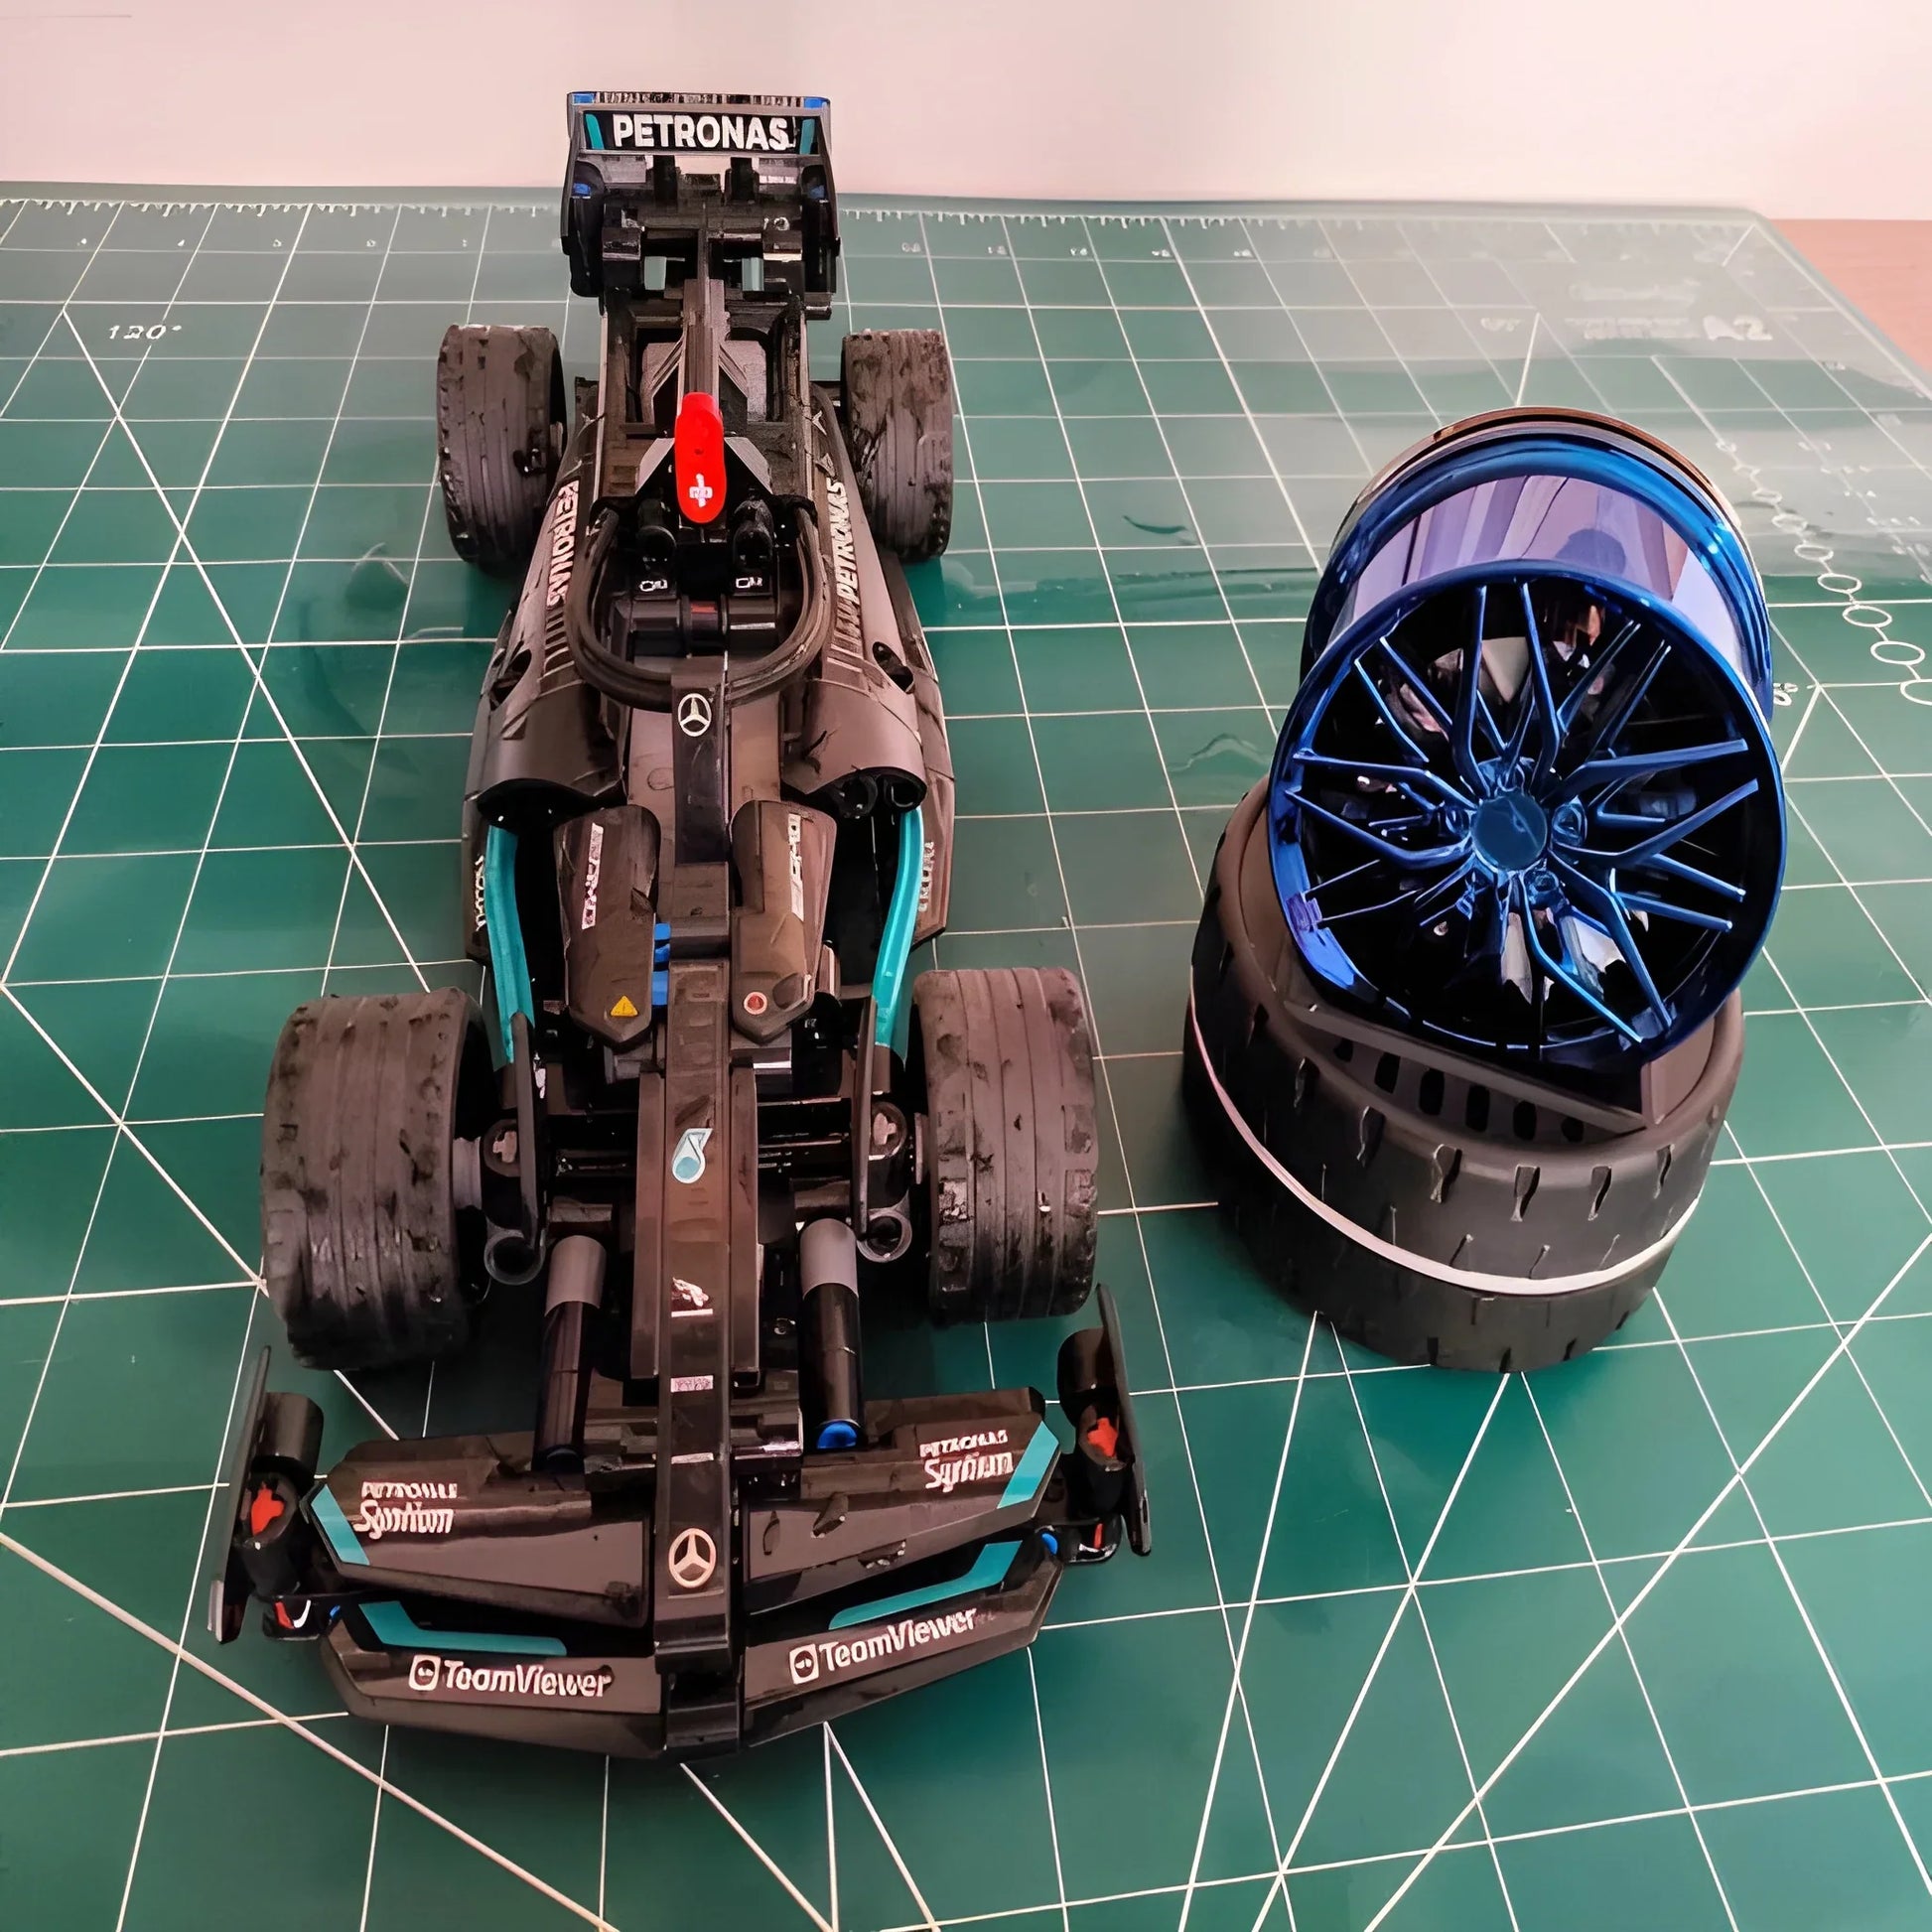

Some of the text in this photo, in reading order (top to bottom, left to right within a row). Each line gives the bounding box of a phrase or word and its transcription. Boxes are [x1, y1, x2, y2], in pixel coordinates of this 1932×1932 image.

[612, 113, 790, 151] PETRONAS
[818, 1608, 977, 1671] TeamViewer
[443, 1659, 612, 1698] TeamViewer
